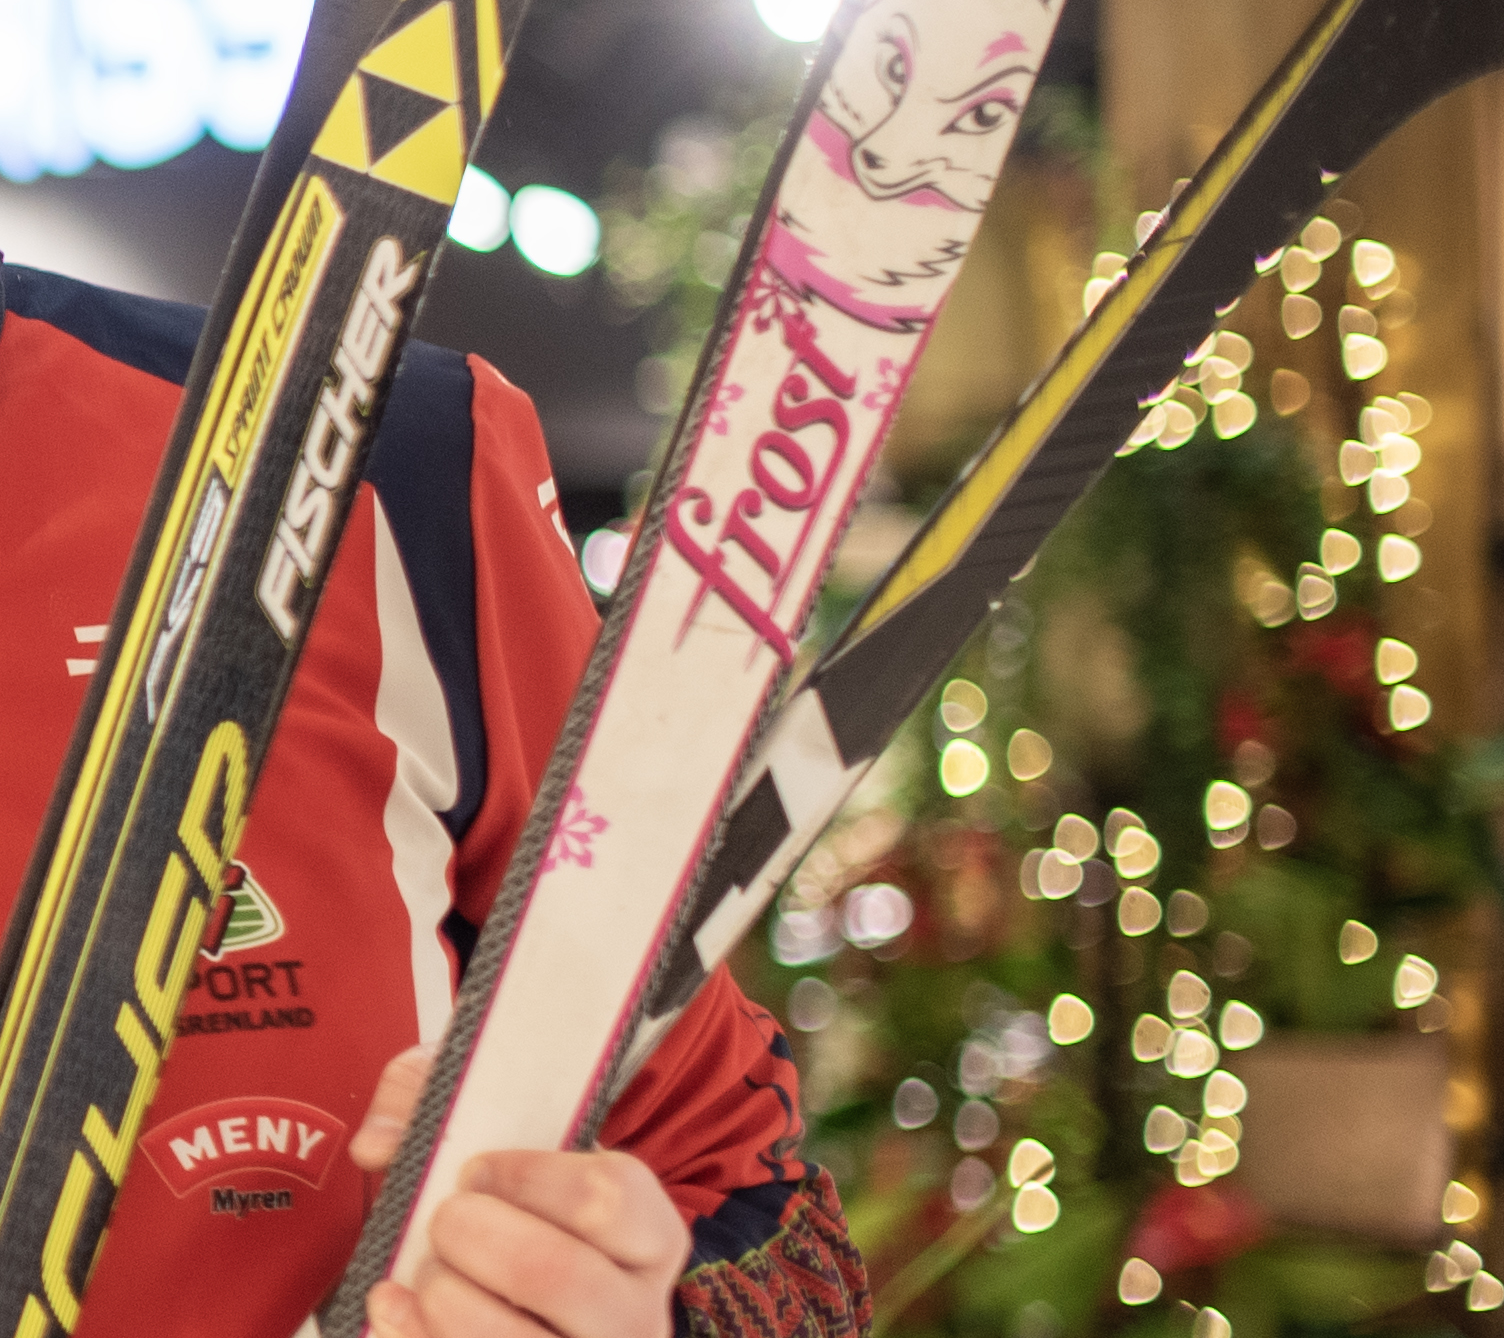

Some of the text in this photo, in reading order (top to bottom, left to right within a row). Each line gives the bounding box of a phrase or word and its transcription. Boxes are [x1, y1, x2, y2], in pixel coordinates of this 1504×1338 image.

[256, 236, 423, 641] FISCHER
[665, 308, 859, 673] frost
[168, 1115, 326, 1171] MENY
[210, 1187, 293, 1219] Myren
